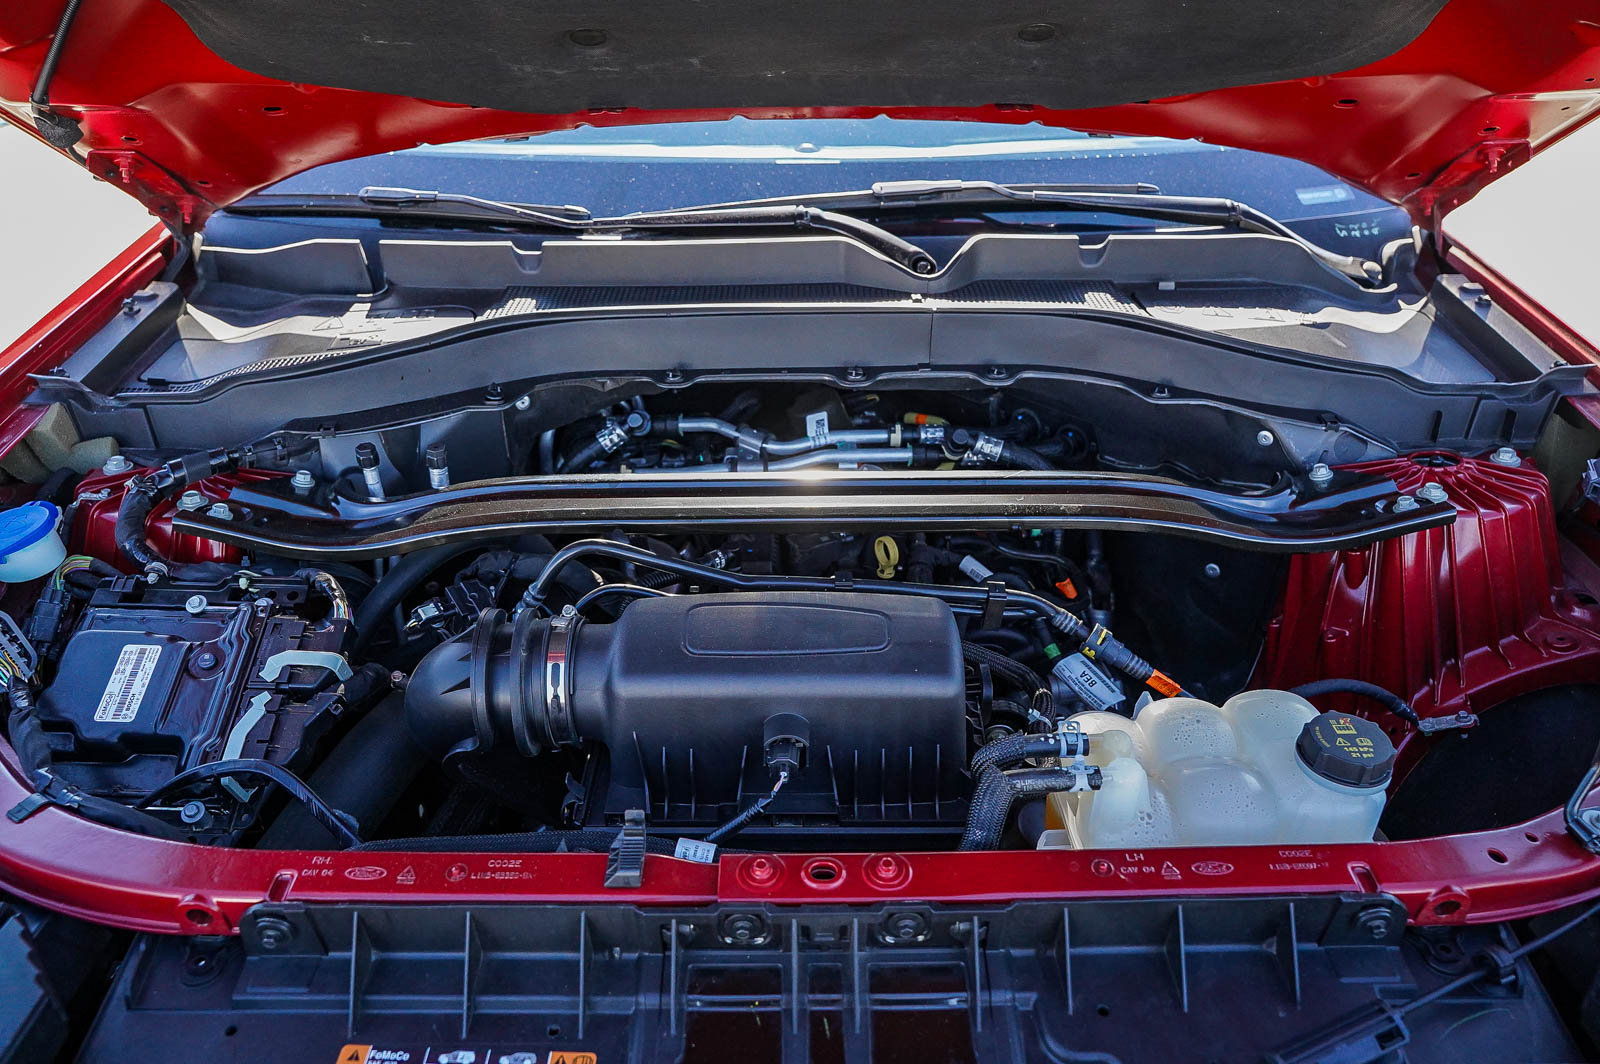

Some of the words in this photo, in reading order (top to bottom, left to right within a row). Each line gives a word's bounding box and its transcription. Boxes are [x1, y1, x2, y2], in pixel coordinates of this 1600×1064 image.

[1080, 670, 1097, 688] BEA
[125, 693, 136, 712] BOSCH
[1125, 853, 1144, 862] LH
[369, 1049, 410, 1061] FoMoCo
